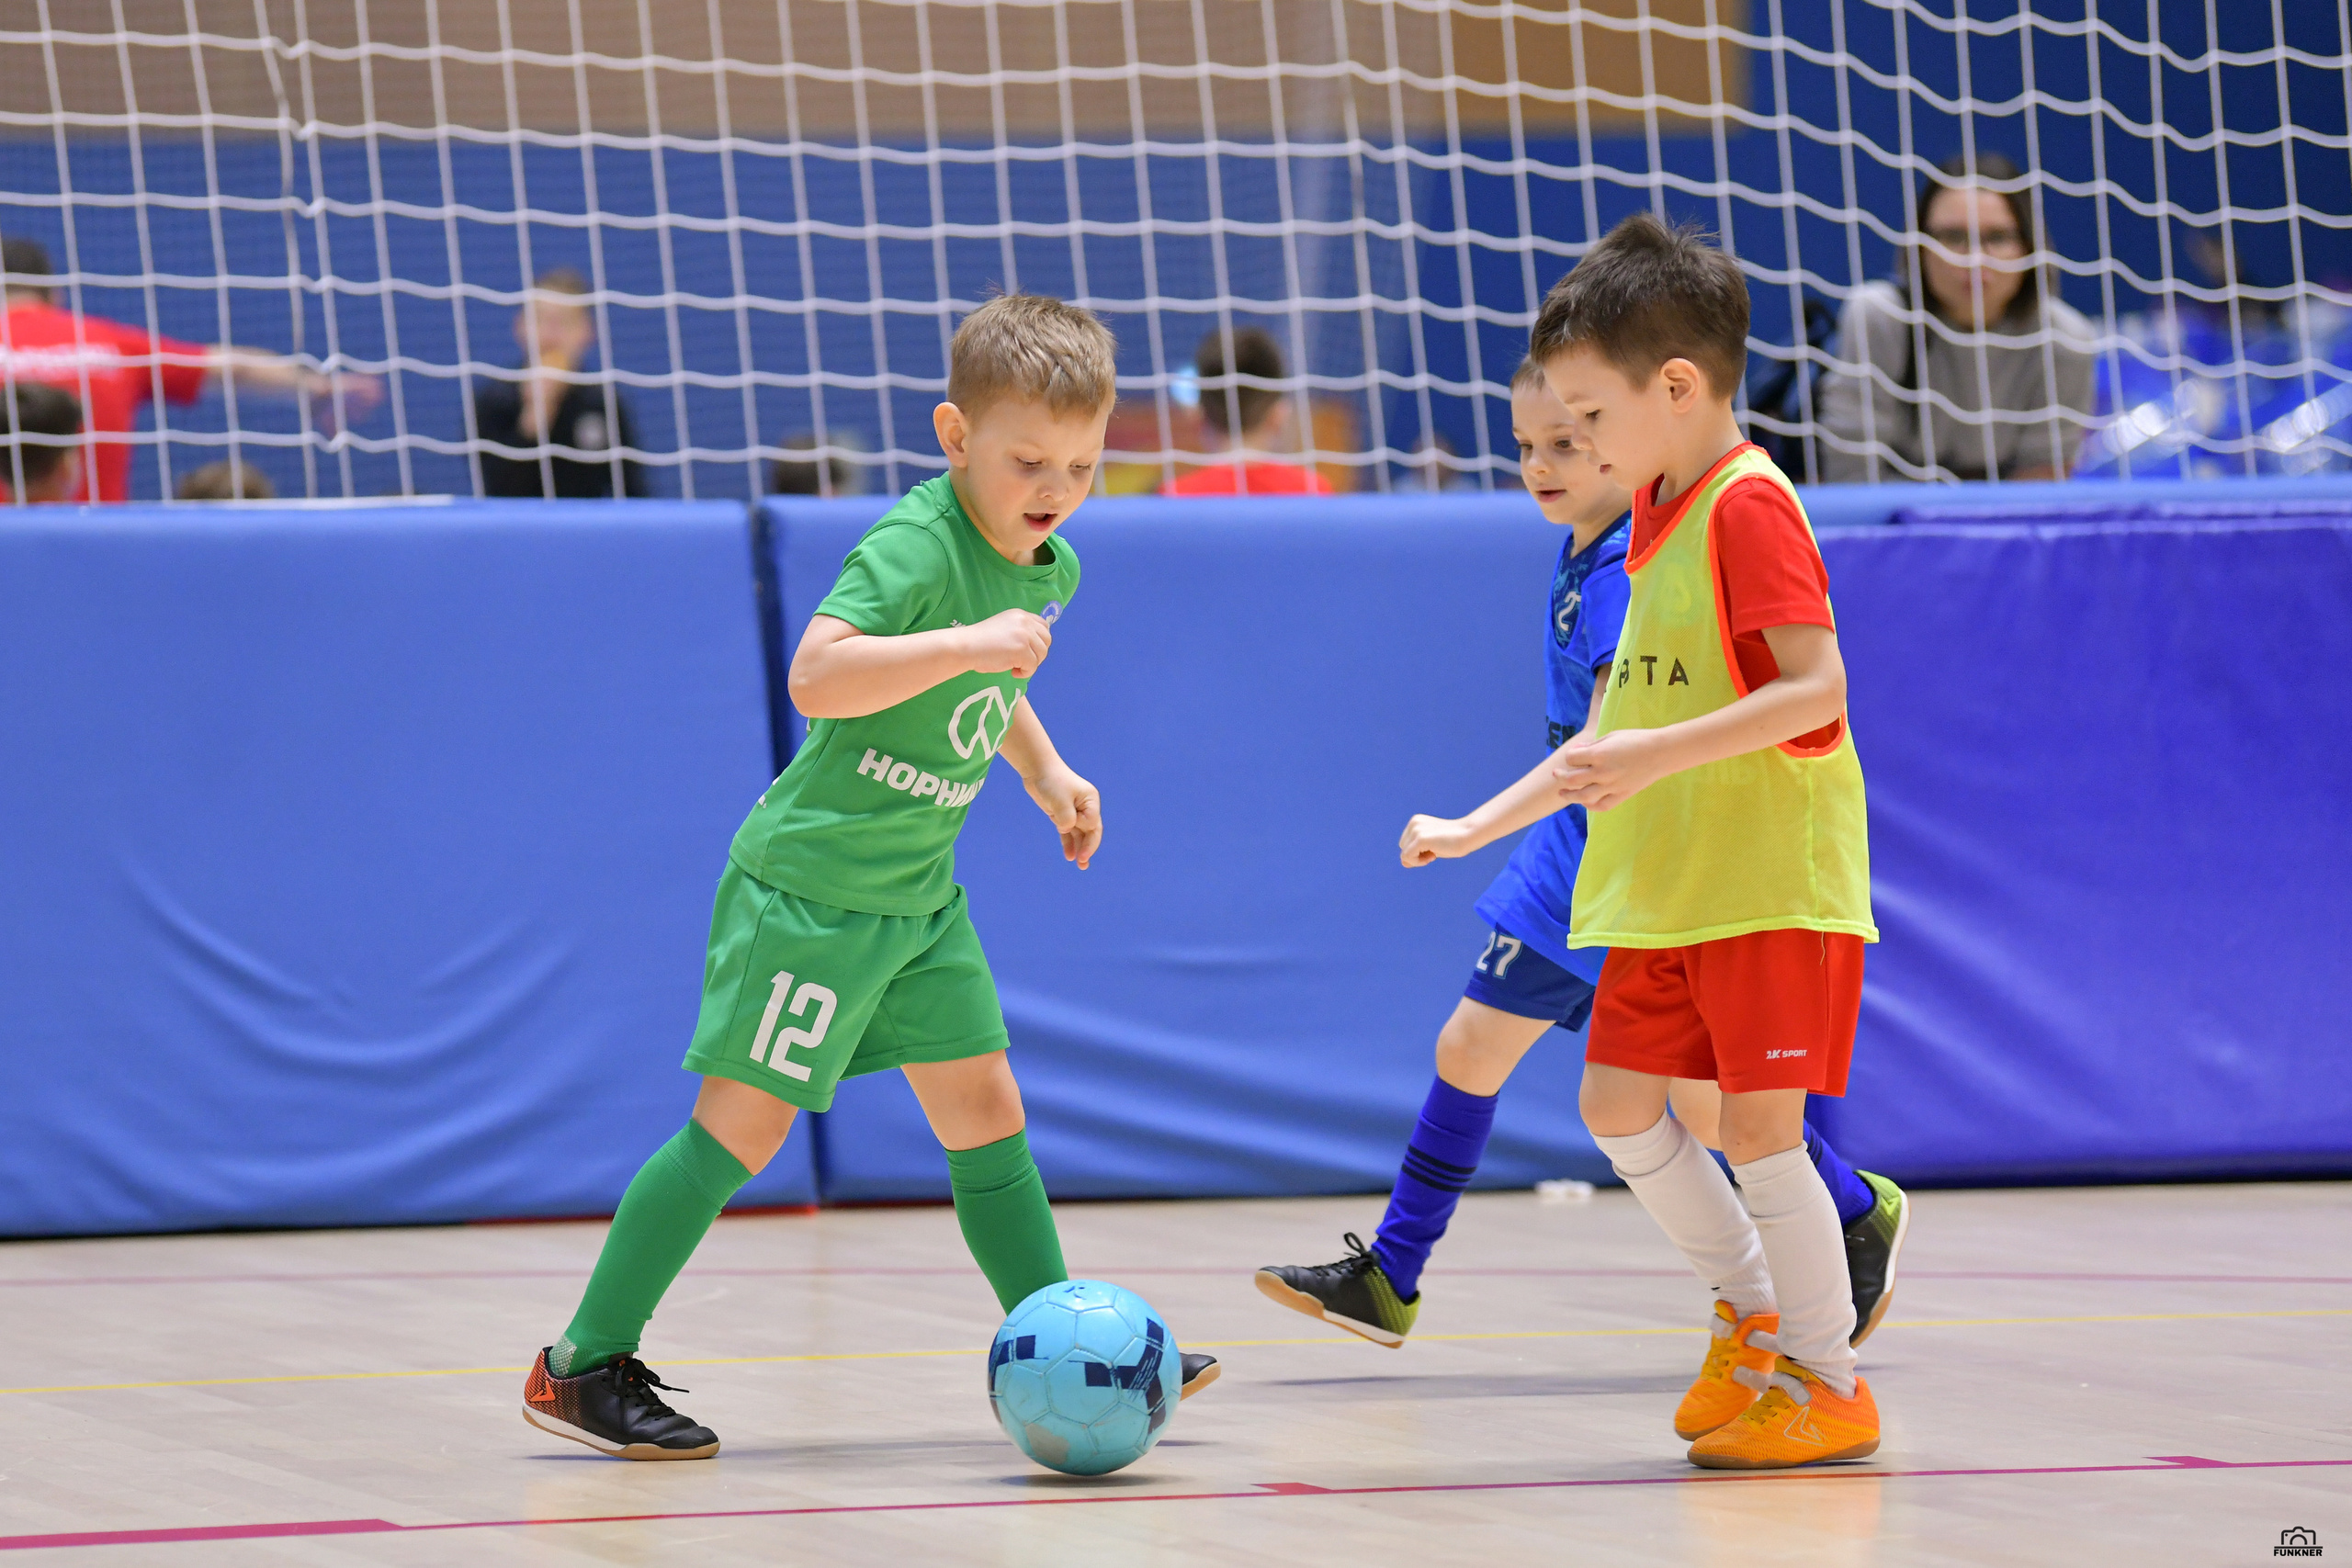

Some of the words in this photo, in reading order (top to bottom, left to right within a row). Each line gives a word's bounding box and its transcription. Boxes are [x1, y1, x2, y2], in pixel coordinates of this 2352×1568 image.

[1558, 591, 1583, 632] 2
[1476, 931, 1522, 977] 27
[749, 970, 837, 1082] 12
[1782, 1049, 1807, 1058] SPORT
